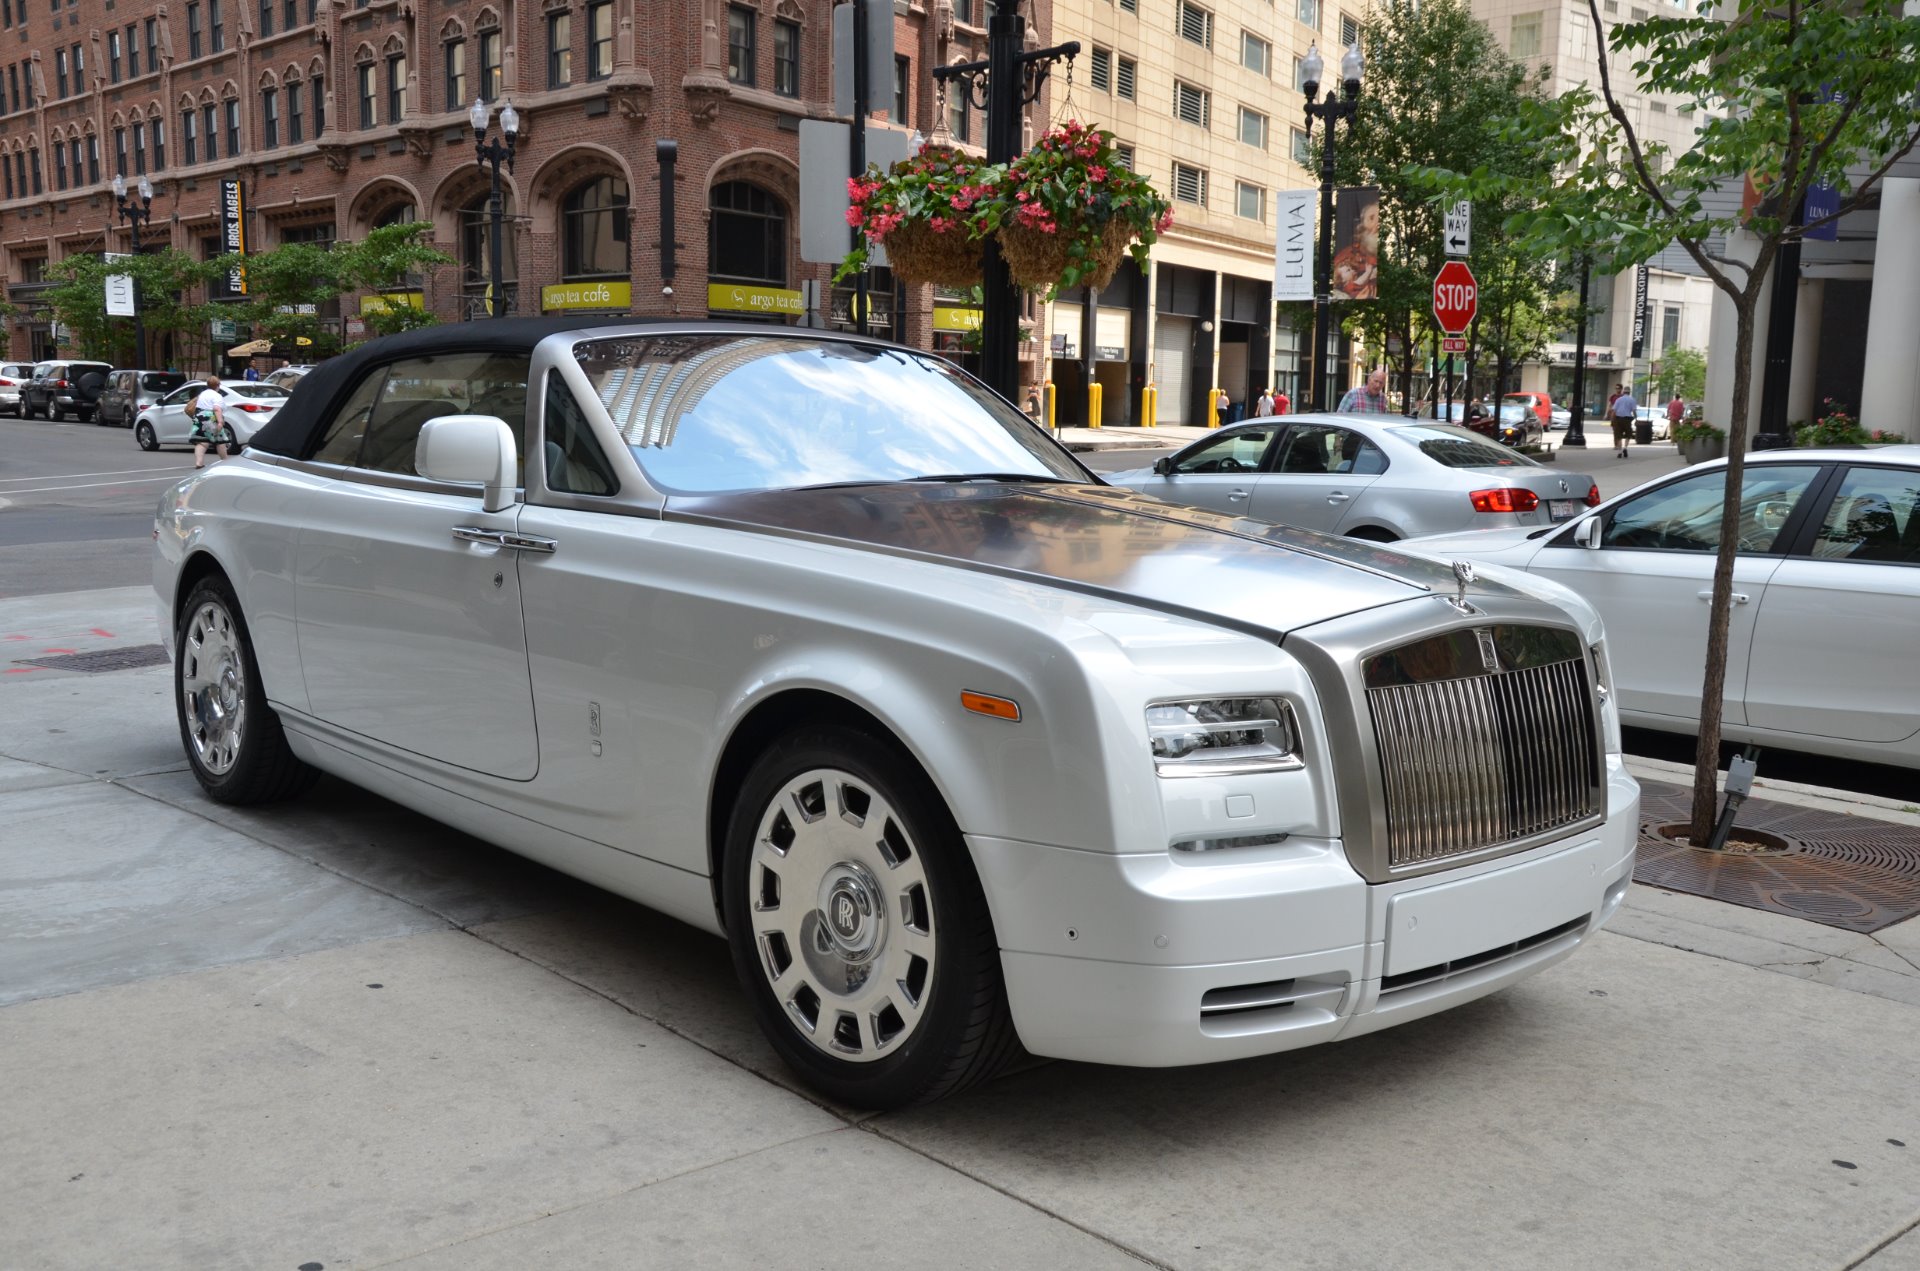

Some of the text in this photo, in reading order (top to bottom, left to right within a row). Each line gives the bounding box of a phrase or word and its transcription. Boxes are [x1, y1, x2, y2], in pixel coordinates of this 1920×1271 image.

[226, 182, 238, 219] BAGELS
[227, 222, 240, 247] BROS.
[1447, 218, 1468, 232] WAY
[1285, 203, 1306, 278] LUMA
[113, 272, 126, 304] LUM
[550, 284, 610, 308] argo tea café
[1436, 284, 1475, 311] STOP
[750, 294, 775, 310] argo
[776, 294, 788, 308] tea
[1633, 265, 1647, 342] ORDSTROM rack
[1444, 340, 1465, 350] ALL WAY
